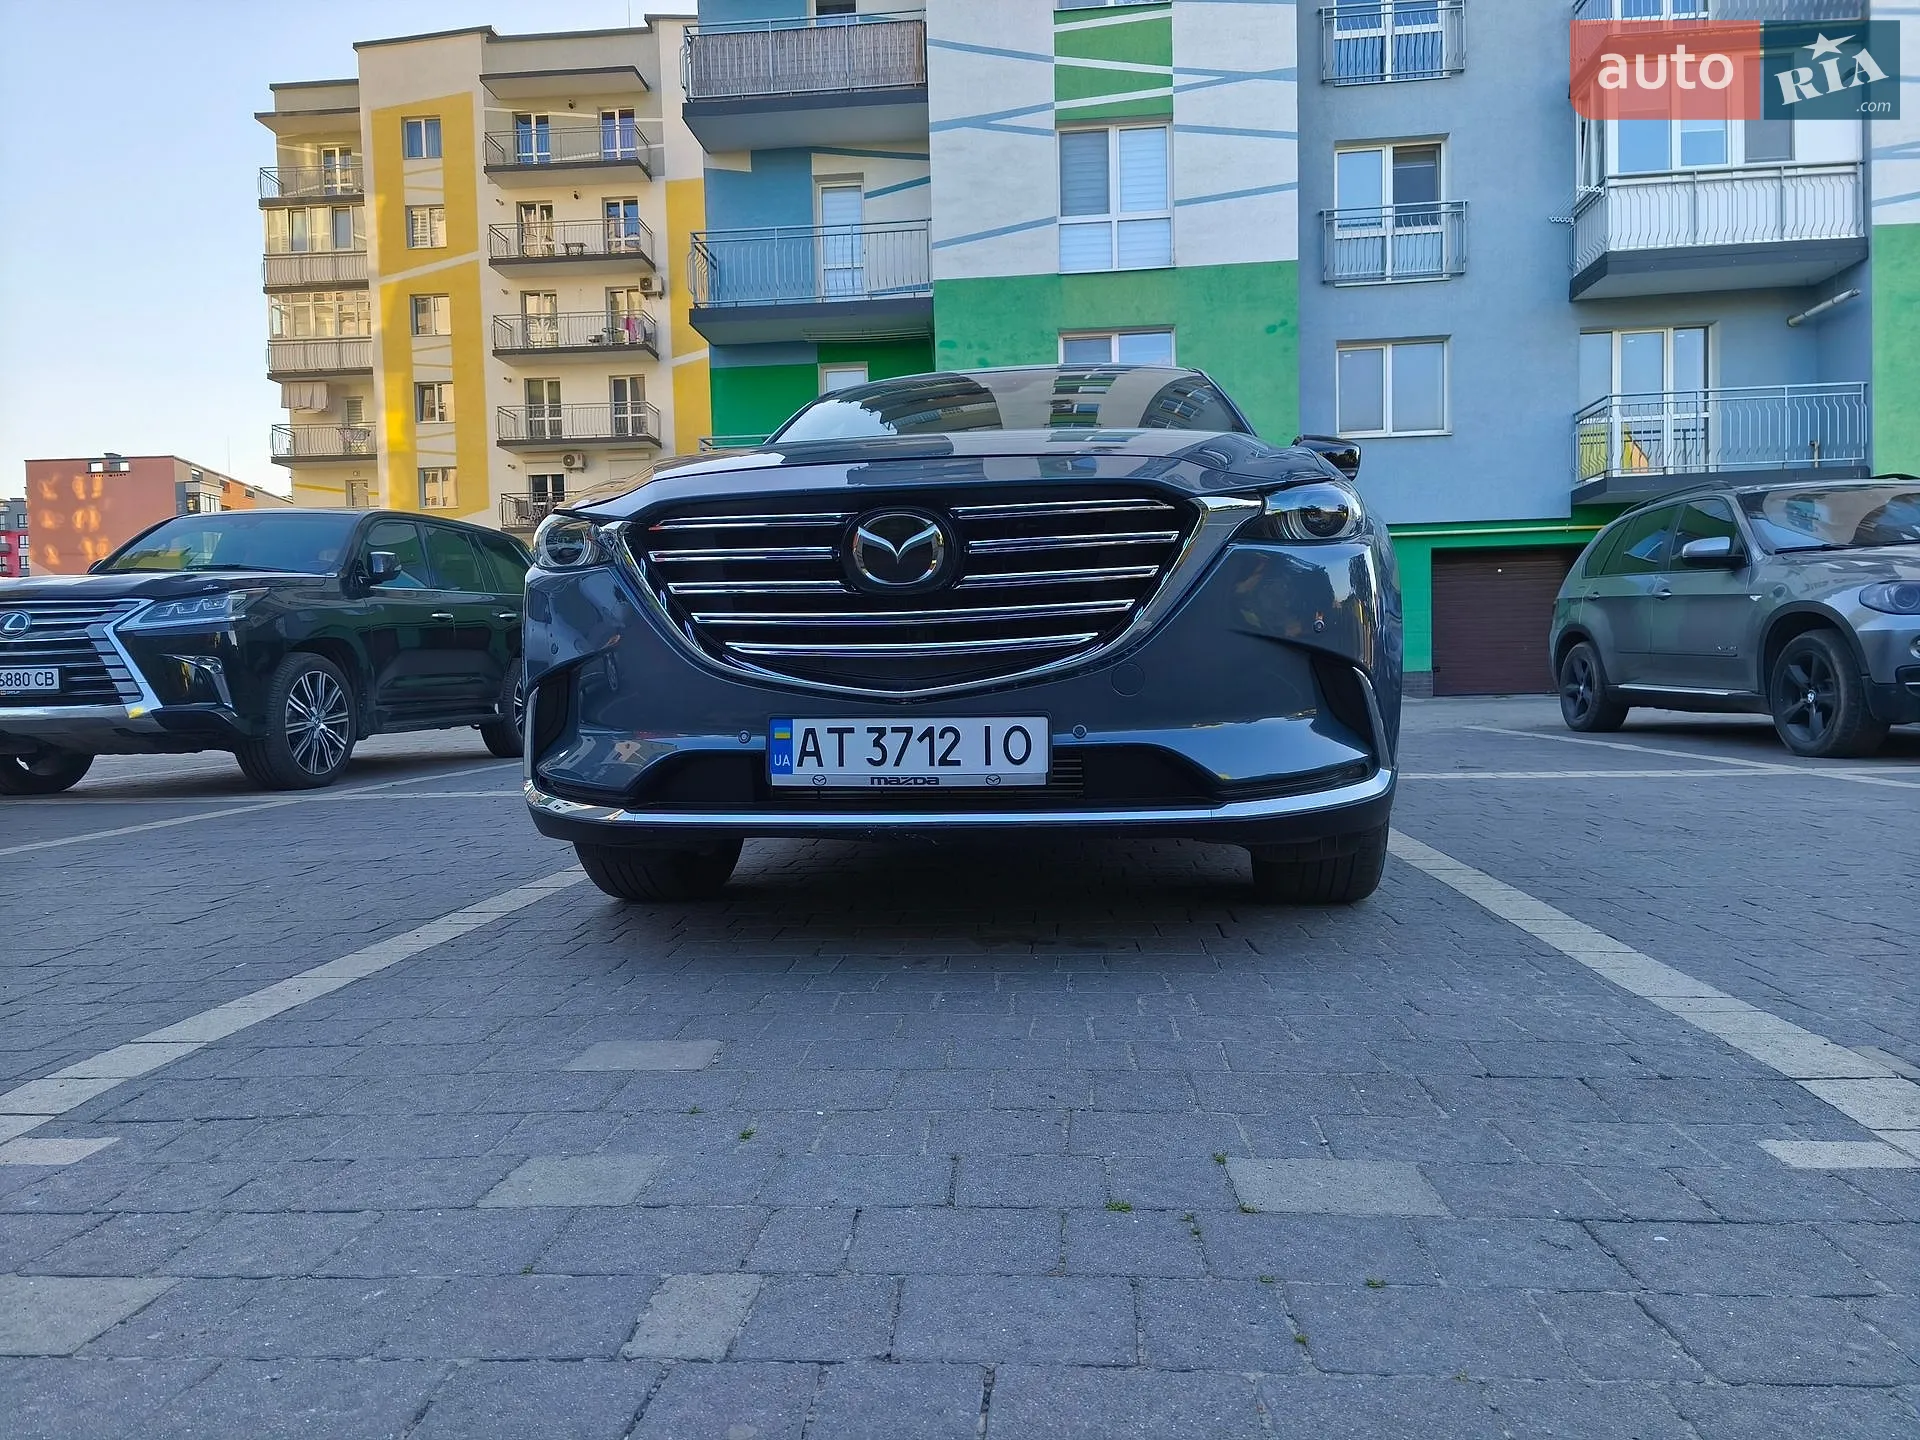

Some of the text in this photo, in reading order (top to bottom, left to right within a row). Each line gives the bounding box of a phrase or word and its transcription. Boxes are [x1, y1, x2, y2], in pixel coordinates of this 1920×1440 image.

[35, 672, 54, 687] CB
[796, 725, 1032, 768] AT 3712 IO
[774, 754, 791, 767] UA
